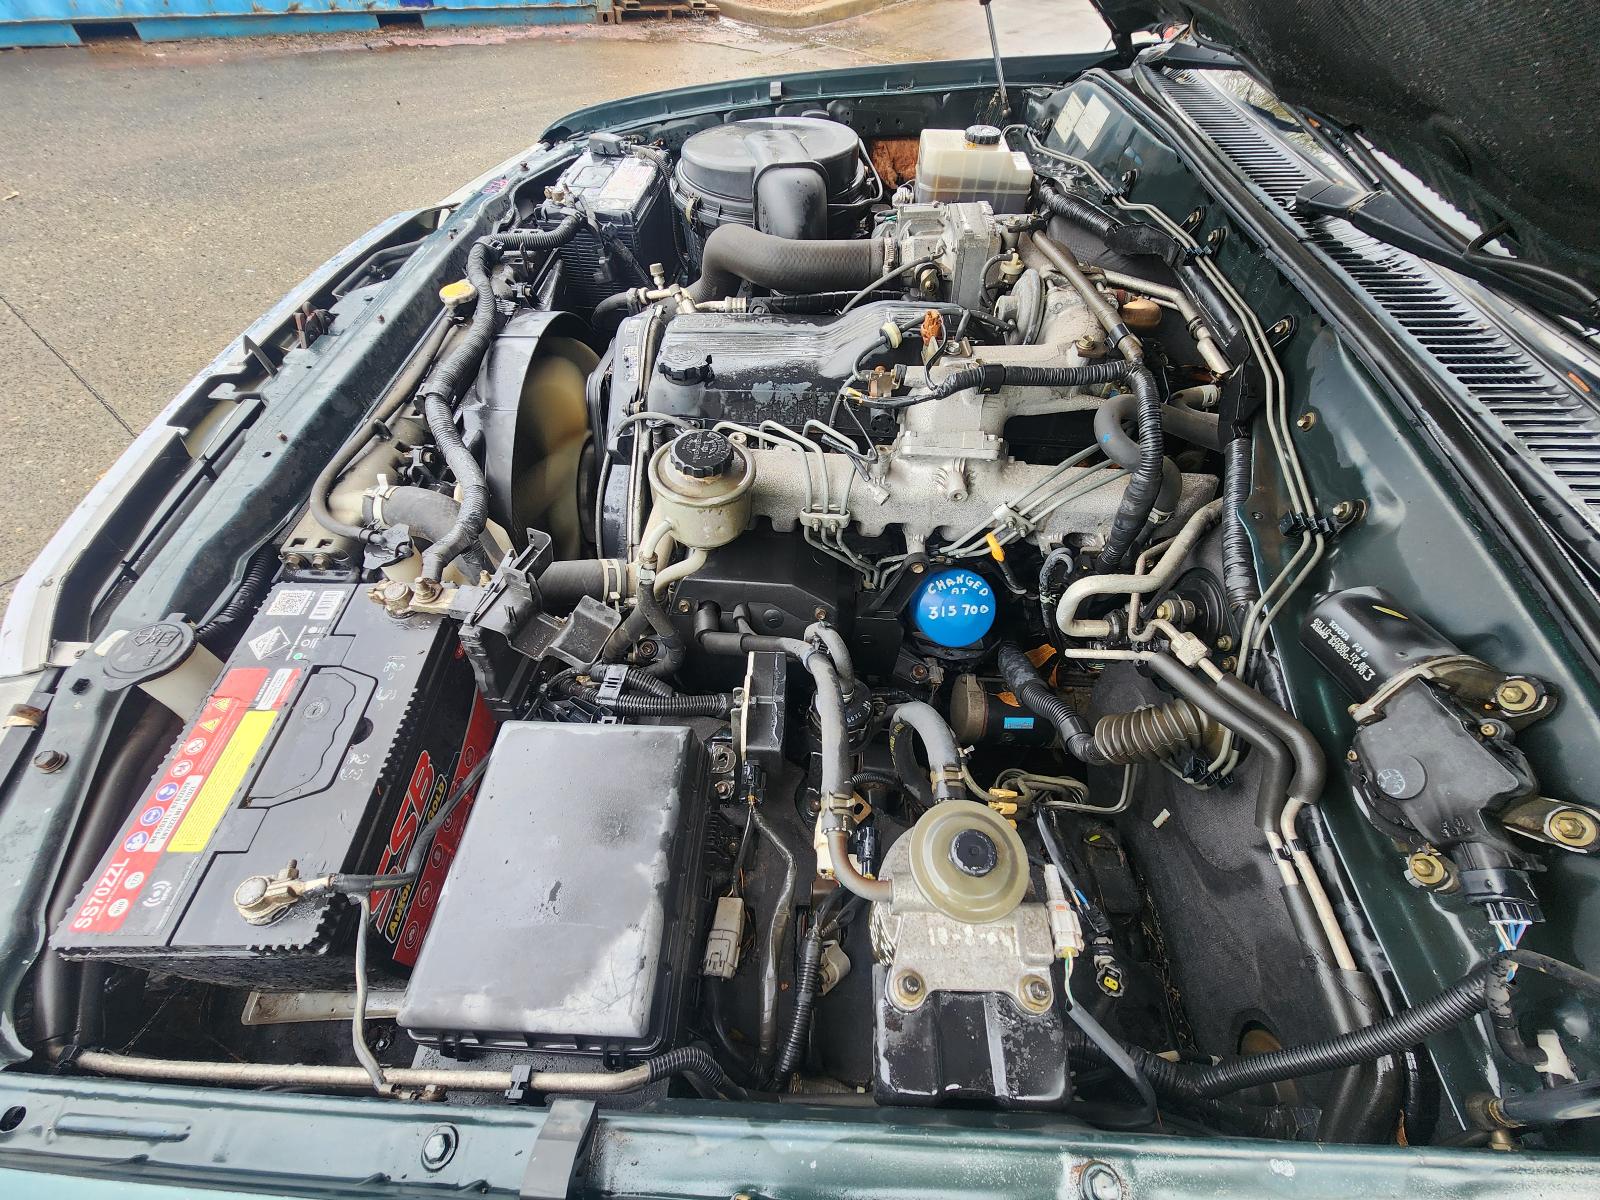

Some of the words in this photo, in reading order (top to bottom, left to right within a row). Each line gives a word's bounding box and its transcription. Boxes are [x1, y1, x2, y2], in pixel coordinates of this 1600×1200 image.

[927, 574, 989, 596] CHANGED
[951, 587, 968, 595] AT
[928, 605, 957, 620] 315
[962, 604, 990, 616] 700
[1329, 620, 1350, 641] TOYOTA
[369, 750, 435, 935] SSB
[74, 858, 130, 929] SS70ZZL
